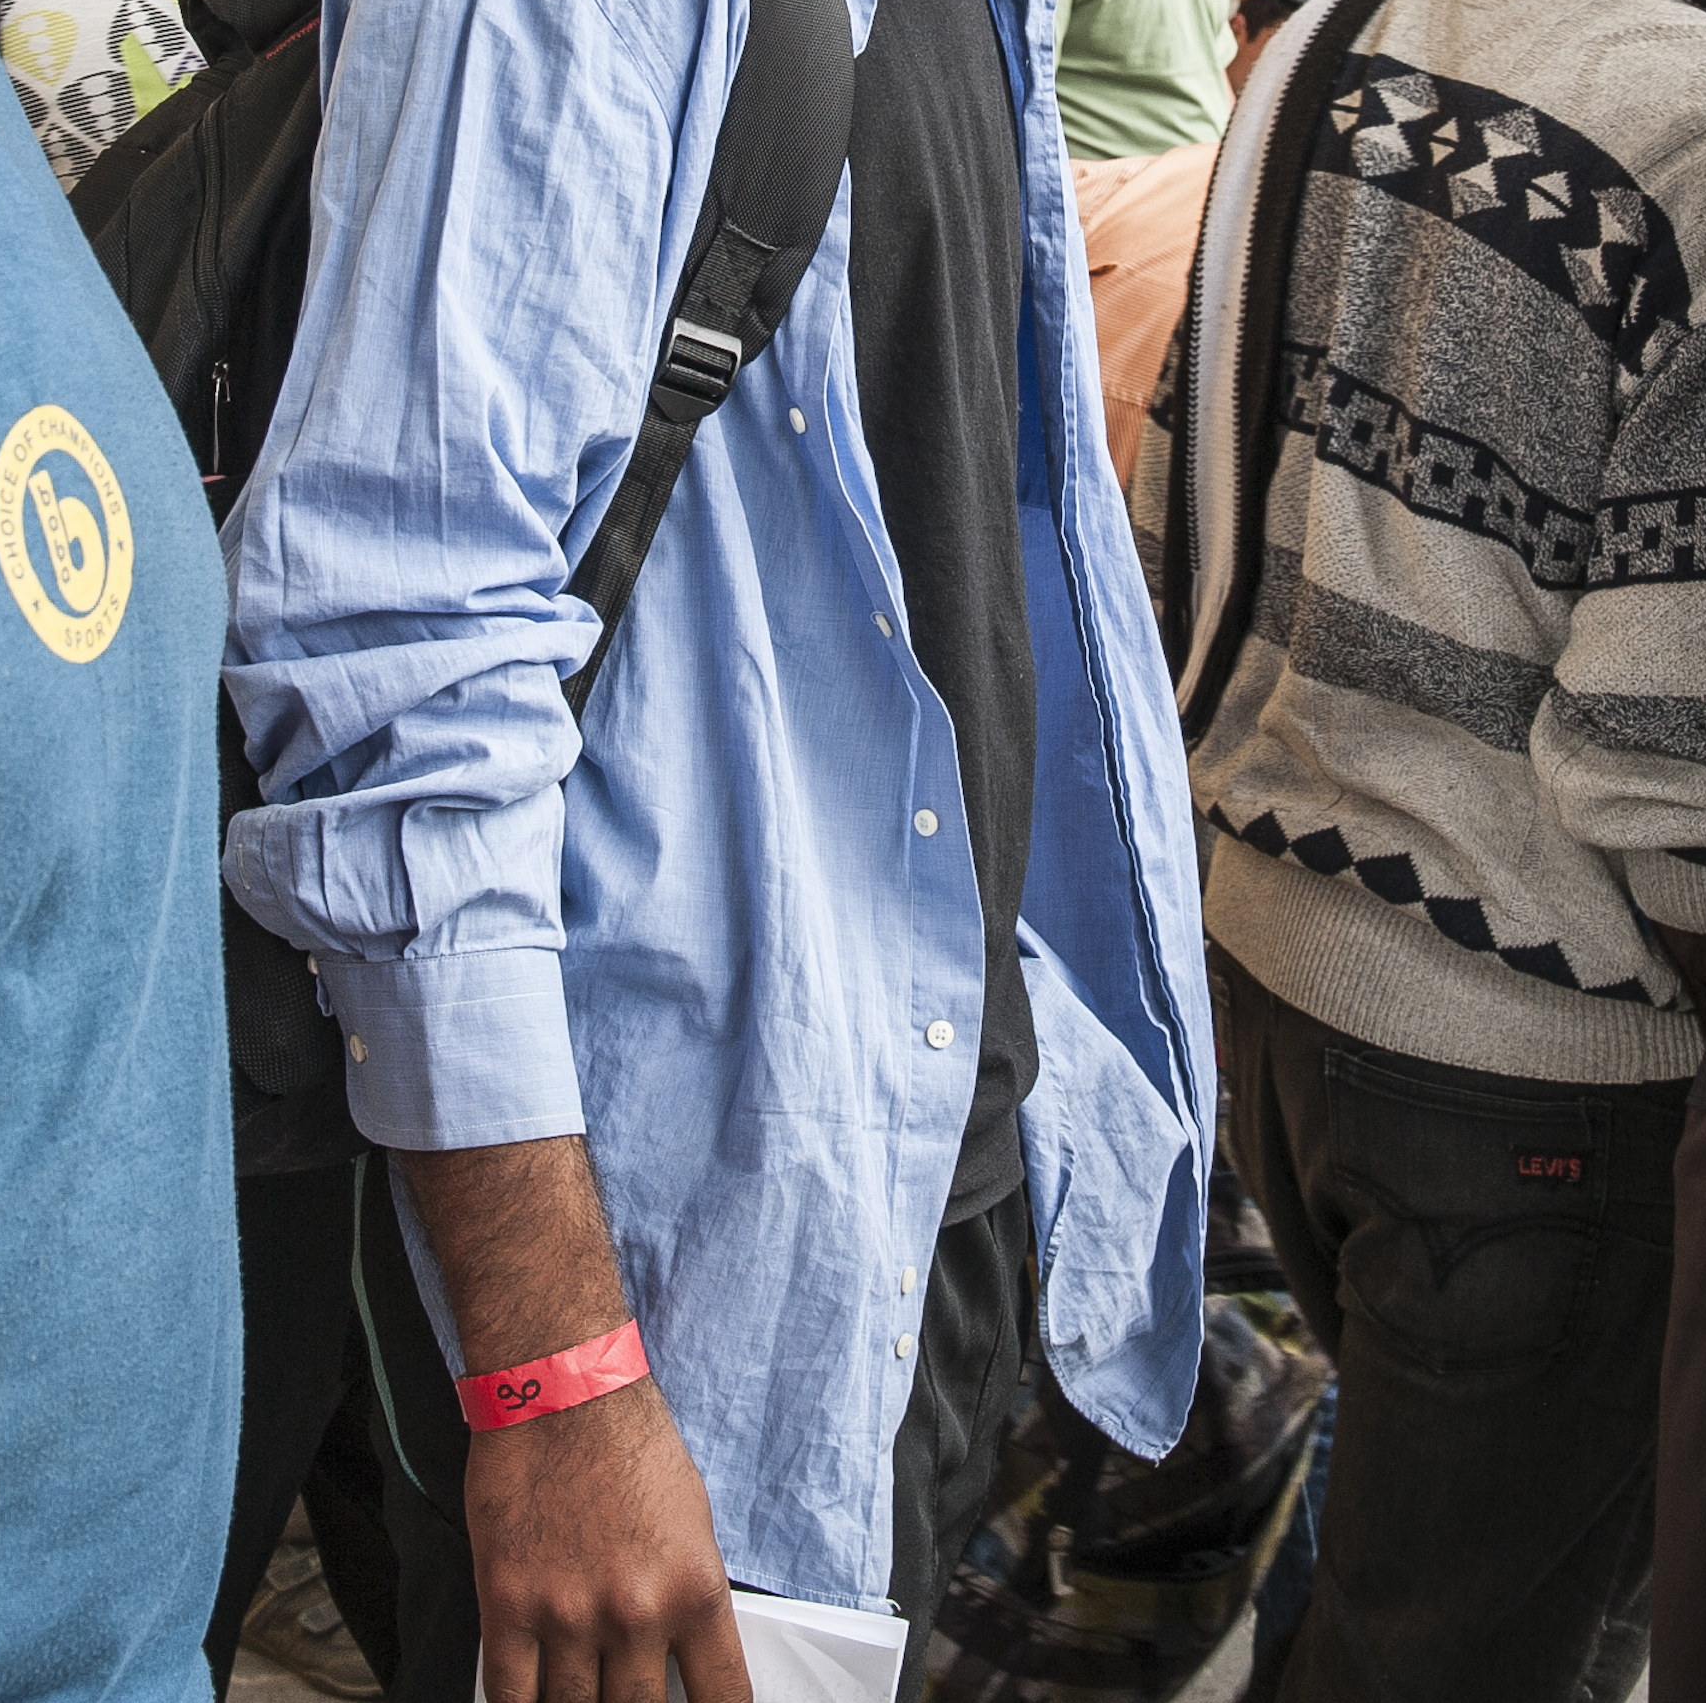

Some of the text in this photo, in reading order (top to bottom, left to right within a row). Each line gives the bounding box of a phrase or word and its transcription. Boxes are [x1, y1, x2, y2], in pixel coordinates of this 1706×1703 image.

[0, 418, 122, 580] CHOICE OF CHAMPIONS
[63, 592, 120, 651] SPORTS
